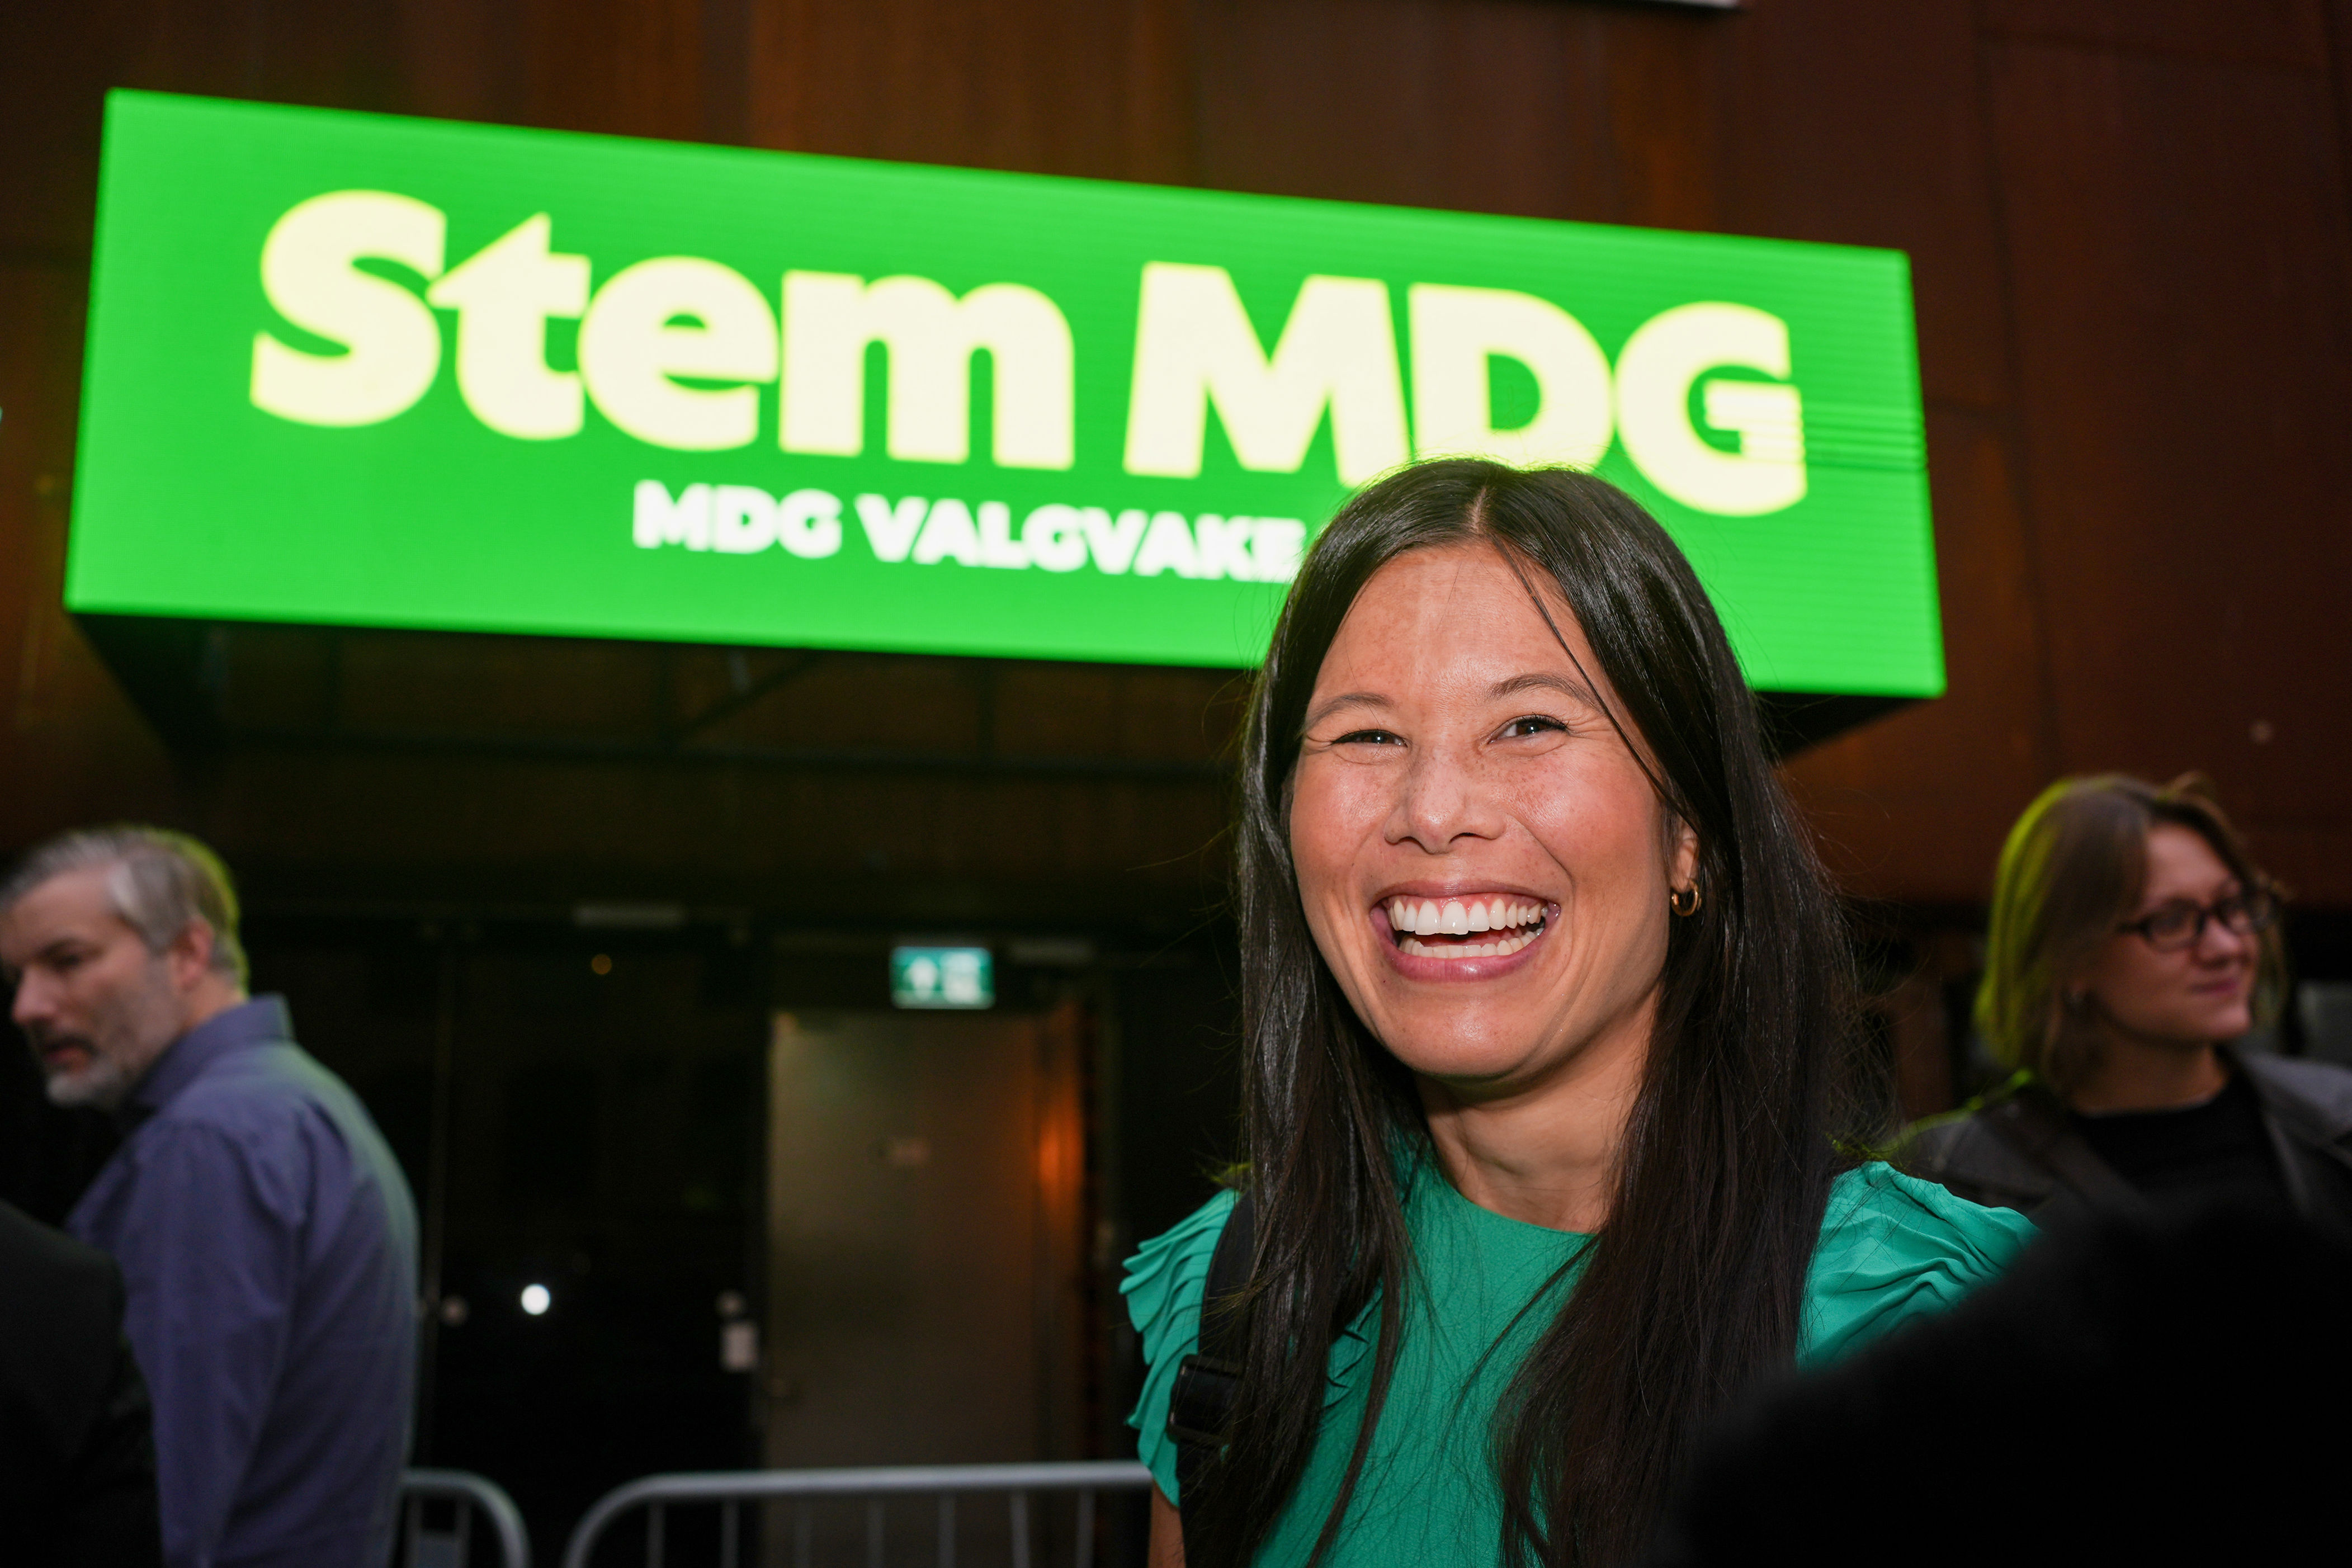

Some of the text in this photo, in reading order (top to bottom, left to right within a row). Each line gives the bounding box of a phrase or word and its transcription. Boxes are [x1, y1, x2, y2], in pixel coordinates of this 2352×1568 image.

[250, 188, 1807, 516] Stem MDG
[632, 479, 1306, 584] MDG VALGVAKE
